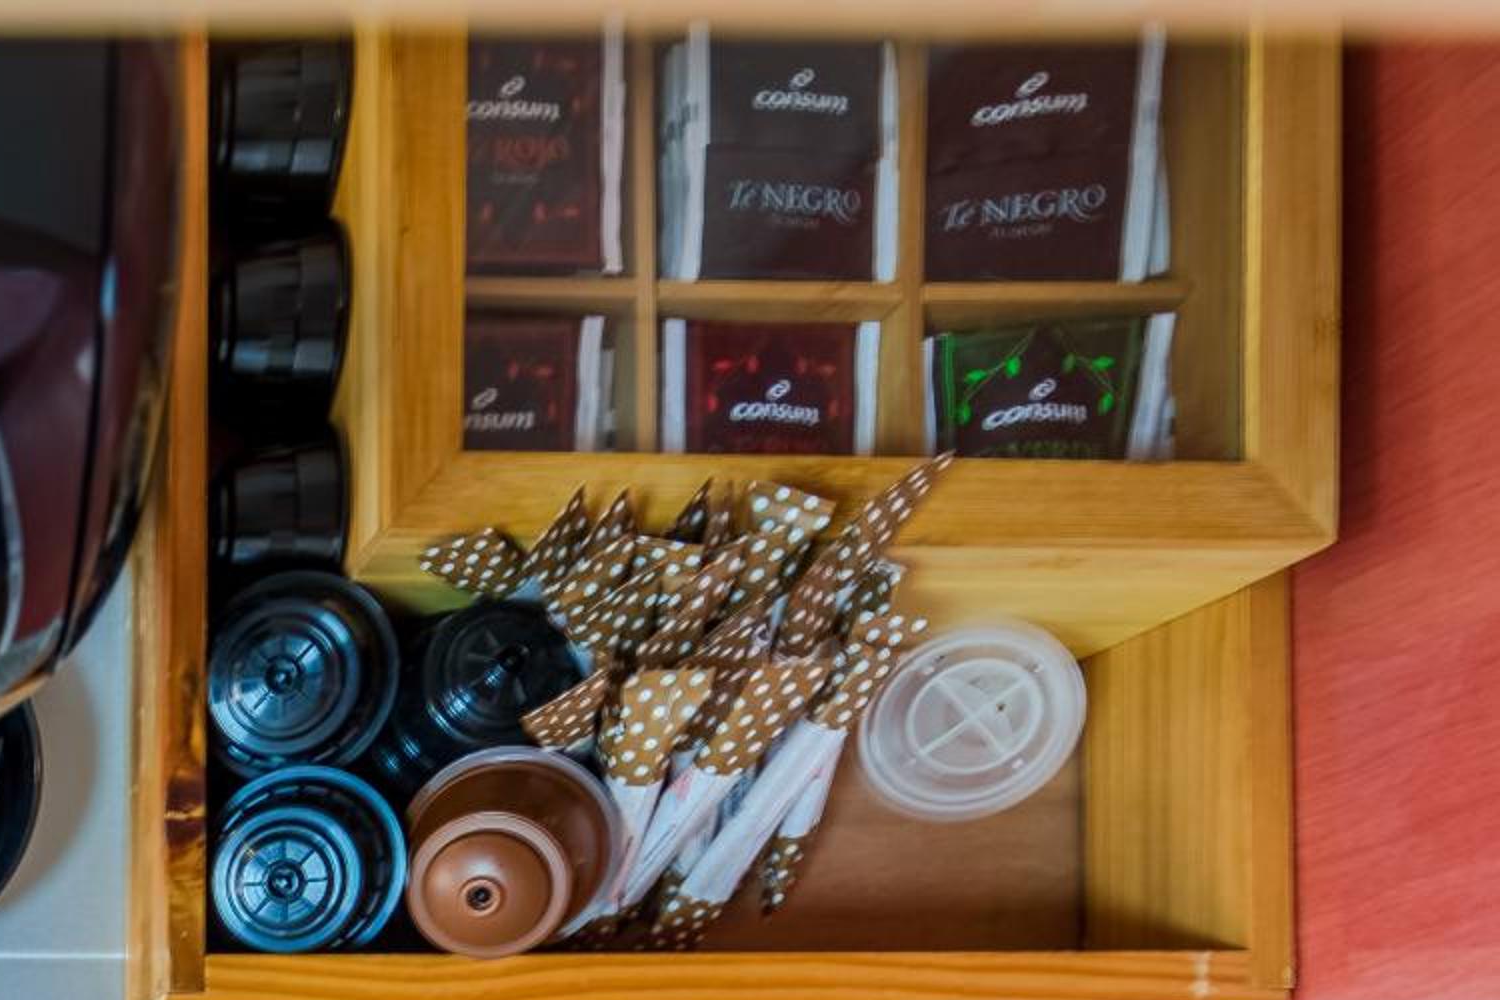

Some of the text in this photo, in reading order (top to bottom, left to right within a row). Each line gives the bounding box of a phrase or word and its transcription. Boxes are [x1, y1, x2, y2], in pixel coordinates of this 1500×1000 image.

[466, 100, 561, 122] consum
[753, 91, 849, 116] consum
[970, 92, 1088, 127] consum
[759, 182, 861, 225] NEGRO
[980, 184, 1107, 226] NEGRO
[728, 402, 820, 426] consum
[981, 401, 1088, 431] consum
